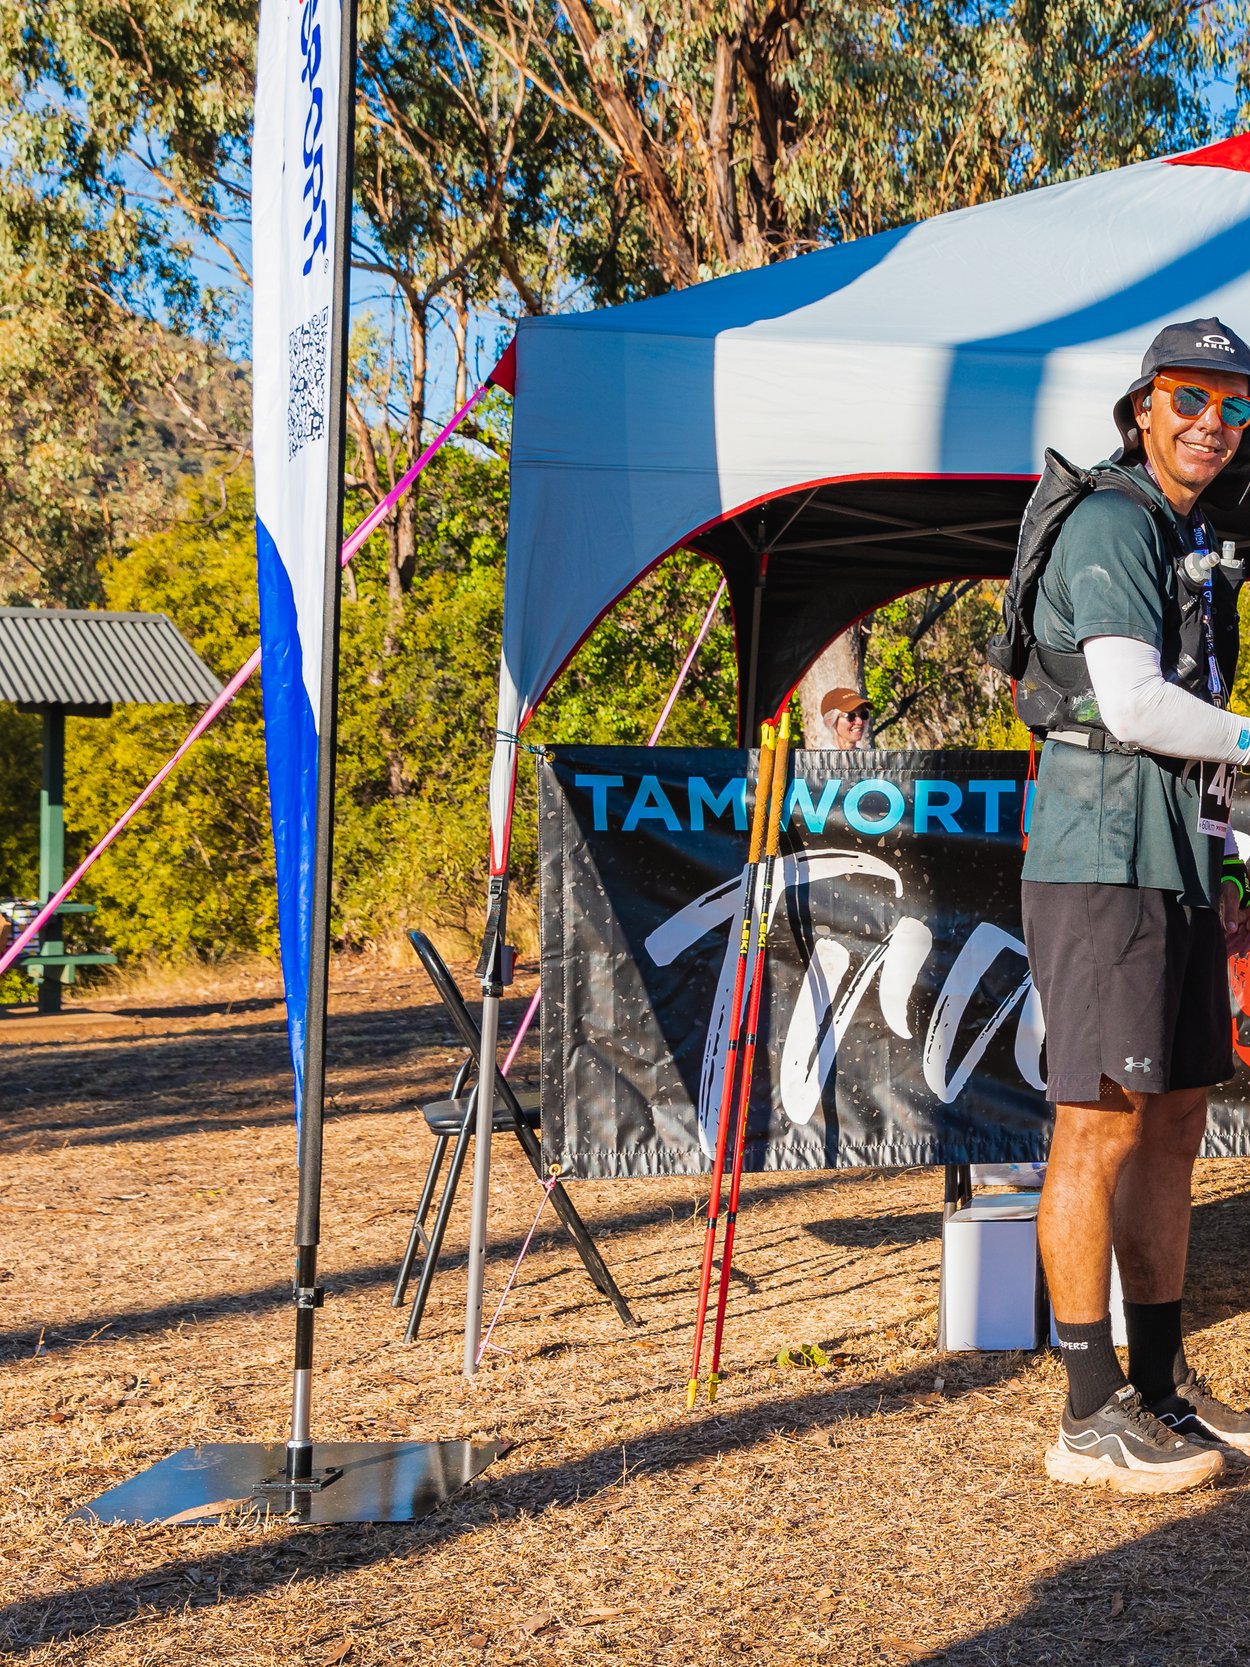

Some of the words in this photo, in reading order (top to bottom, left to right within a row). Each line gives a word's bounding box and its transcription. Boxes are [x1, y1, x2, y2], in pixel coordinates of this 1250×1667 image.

[1195, 342, 1236, 354] OAKLEY
[574, 774, 1038, 835] TAMWORT
[740, 919, 751, 954] LEKI
[757, 912, 769, 948] LEKI
